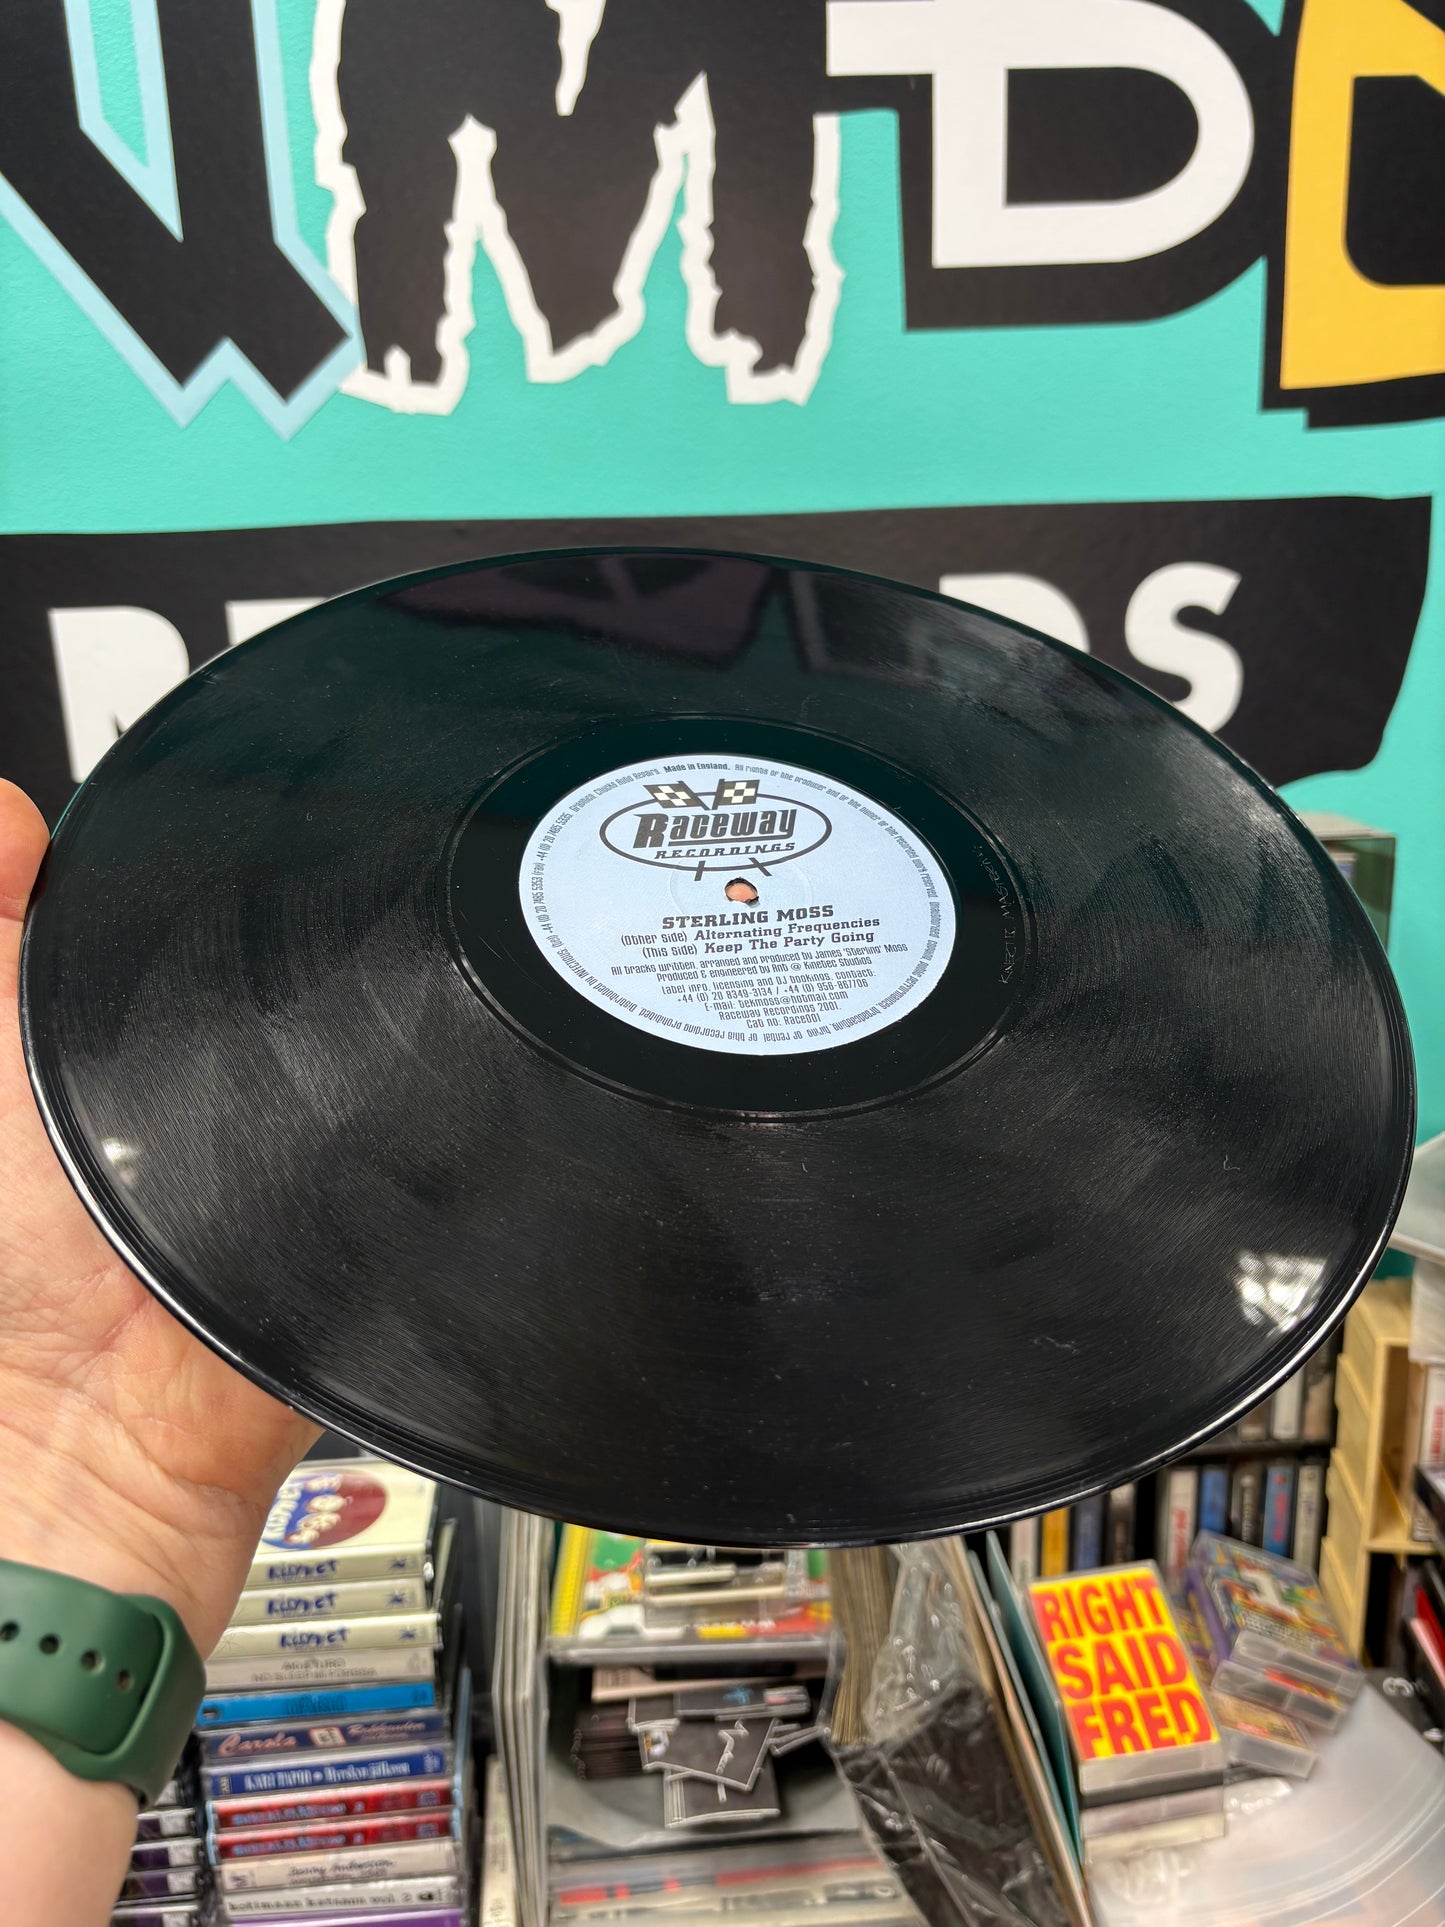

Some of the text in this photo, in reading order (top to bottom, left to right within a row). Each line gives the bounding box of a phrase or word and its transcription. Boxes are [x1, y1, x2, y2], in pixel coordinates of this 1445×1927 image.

[663, 762, 728, 773] Made in England.
[734, 763, 744, 771] All
[745, 765, 769, 775] rights
[769, 769, 779, 777] of
[779, 771, 794, 781] the
[794, 776, 827, 792] producer
[825, 788, 841, 798] and
[838, 794, 850, 802] of
[847, 798, 862, 810] the
[859, 806, 882, 821] owner
[884, 825, 899, 837] the
[894, 835, 920, 859] recorded
[911, 858, 928, 873] work
[546, 823, 563, 837] 7485
[632, 808, 798, 849] Raceway
[542, 835, 556, 844] 20
[654, 842, 796, 860] RECORDINGS
[531, 876, 544, 891] 5353
[531, 891, 545, 905] 7485
[534, 905, 548, 914] 20
[662, 905, 834, 930] STERLING MOSS
[620, 917, 881, 947] (Other Side) Alternating Frequencies
[642, 931, 875, 959] (This Side) Keep The Party Going
[610, 965, 623, 976] All
[625, 963, 657, 975] tracks
[699, 957, 741, 969] arranged
[742, 955, 759, 966] and
[760, 951, 801, 964] produced
[801, 950, 813, 961] by
[814, 947, 843, 959] James
[883, 943, 909, 953] Moss
[656, 956, 873, 982] Produced & engineered by Ant @ Kinetec Studios
[584, 975, 598, 987] by
[661, 984, 686, 995] Label
[712, 979, 754, 990] licensing
[756, 975, 774, 986] and
[775, 975, 787, 985] DJ
[592, 982, 638, 1013] Distributed
[696, 992, 709, 1003] (0)
[711, 991, 724, 1001] 20
[726, 986, 775, 999] 8349-3134
[775, 985, 780, 996] /
[802, 981, 815, 993] (0)
[817, 978, 869, 992] 956-867706
[703, 990, 849, 1012] E-mail: tekmoss@hotmail.com
[638, 1008, 683, 1030] prohibited.
[718, 1008, 762, 1021] Raceway
[762, 1003, 817, 1016] Recordings
[745, 1012, 822, 1029] Cat no: Race001
[683, 1023, 725, 1039] recording
[727, 1031, 746, 1042] this
[747, 1032, 758, 1042] of
[763, 1032, 791, 1042] rental
[792, 1030, 803, 1040] or
[806, 1025, 832, 1038] hiring
[1031, 1573, 1170, 1641] RIGHT
[1051, 1631, 1190, 1701] SAID
[1072, 1689, 1215, 1759] FRED
